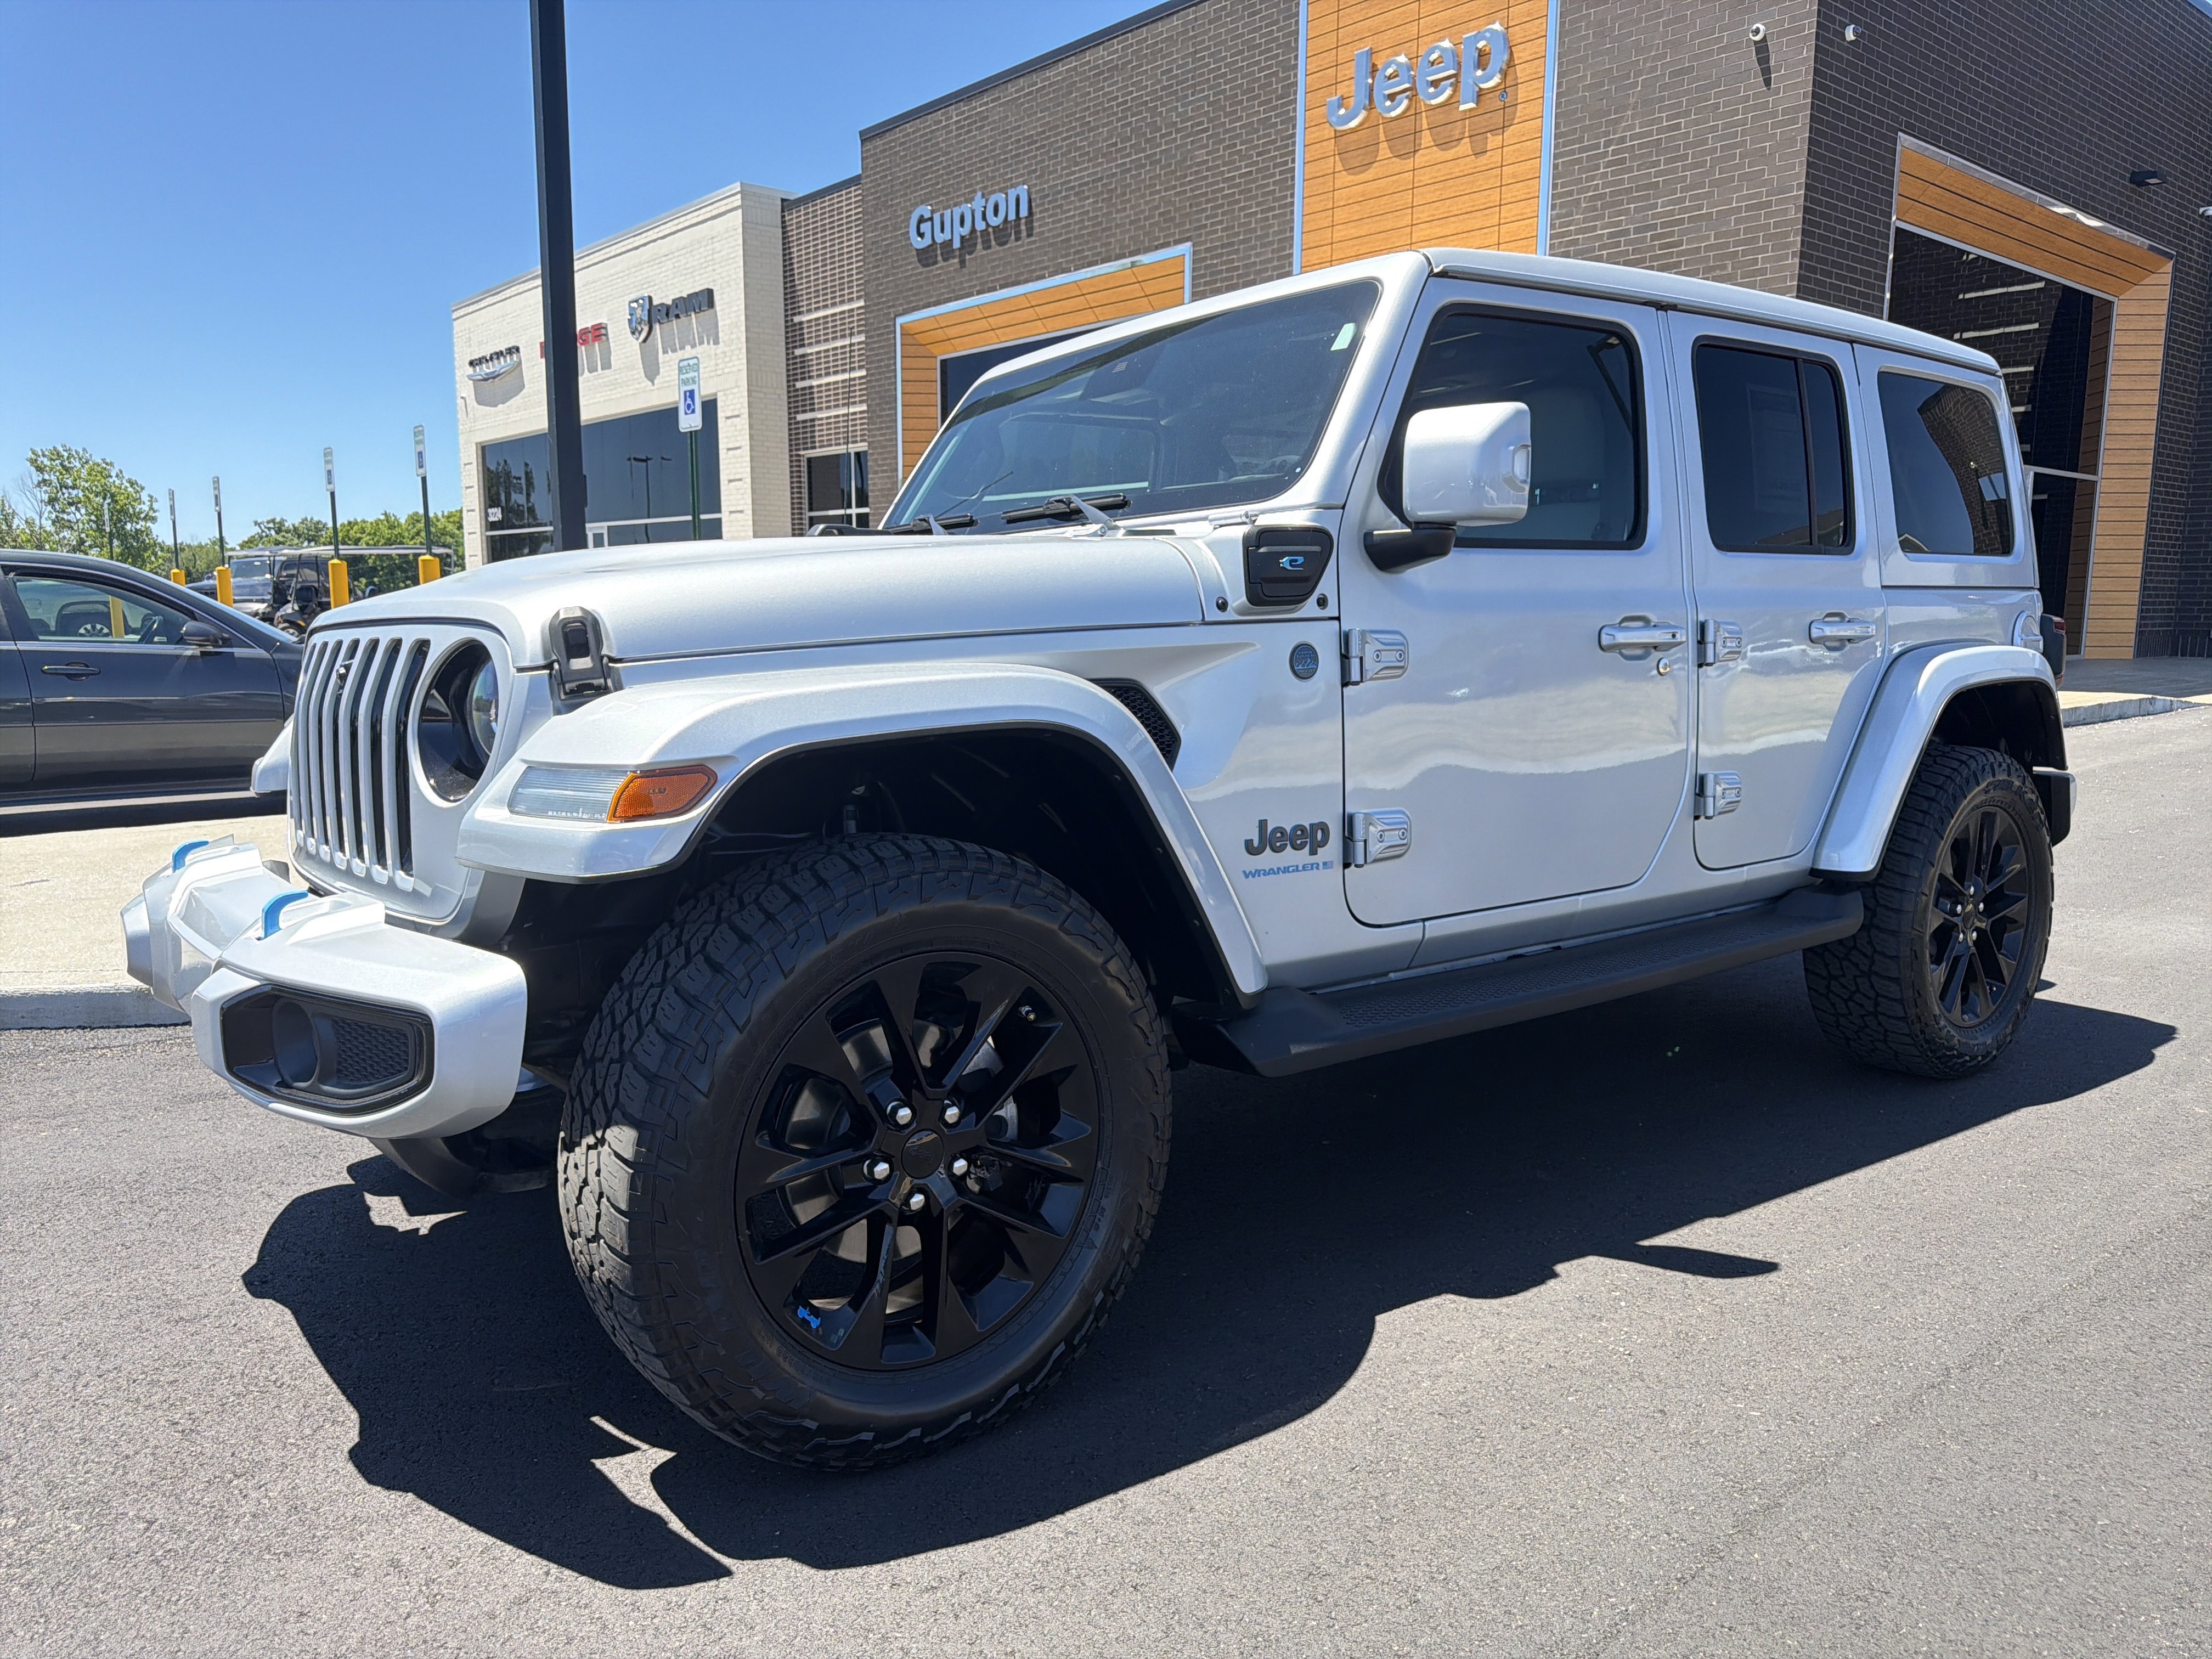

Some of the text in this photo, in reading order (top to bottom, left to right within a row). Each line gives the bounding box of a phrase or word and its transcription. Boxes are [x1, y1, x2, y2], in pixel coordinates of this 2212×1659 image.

[1325, 21, 1510, 130] Jeep
[908, 183, 1030, 250] Gupton
[651, 288, 714, 325] RAM
[487, 507, 502, 522] 3224
[1244, 819, 1330, 856] Jeep
[1242, 862, 1321, 879] WRANGLER
